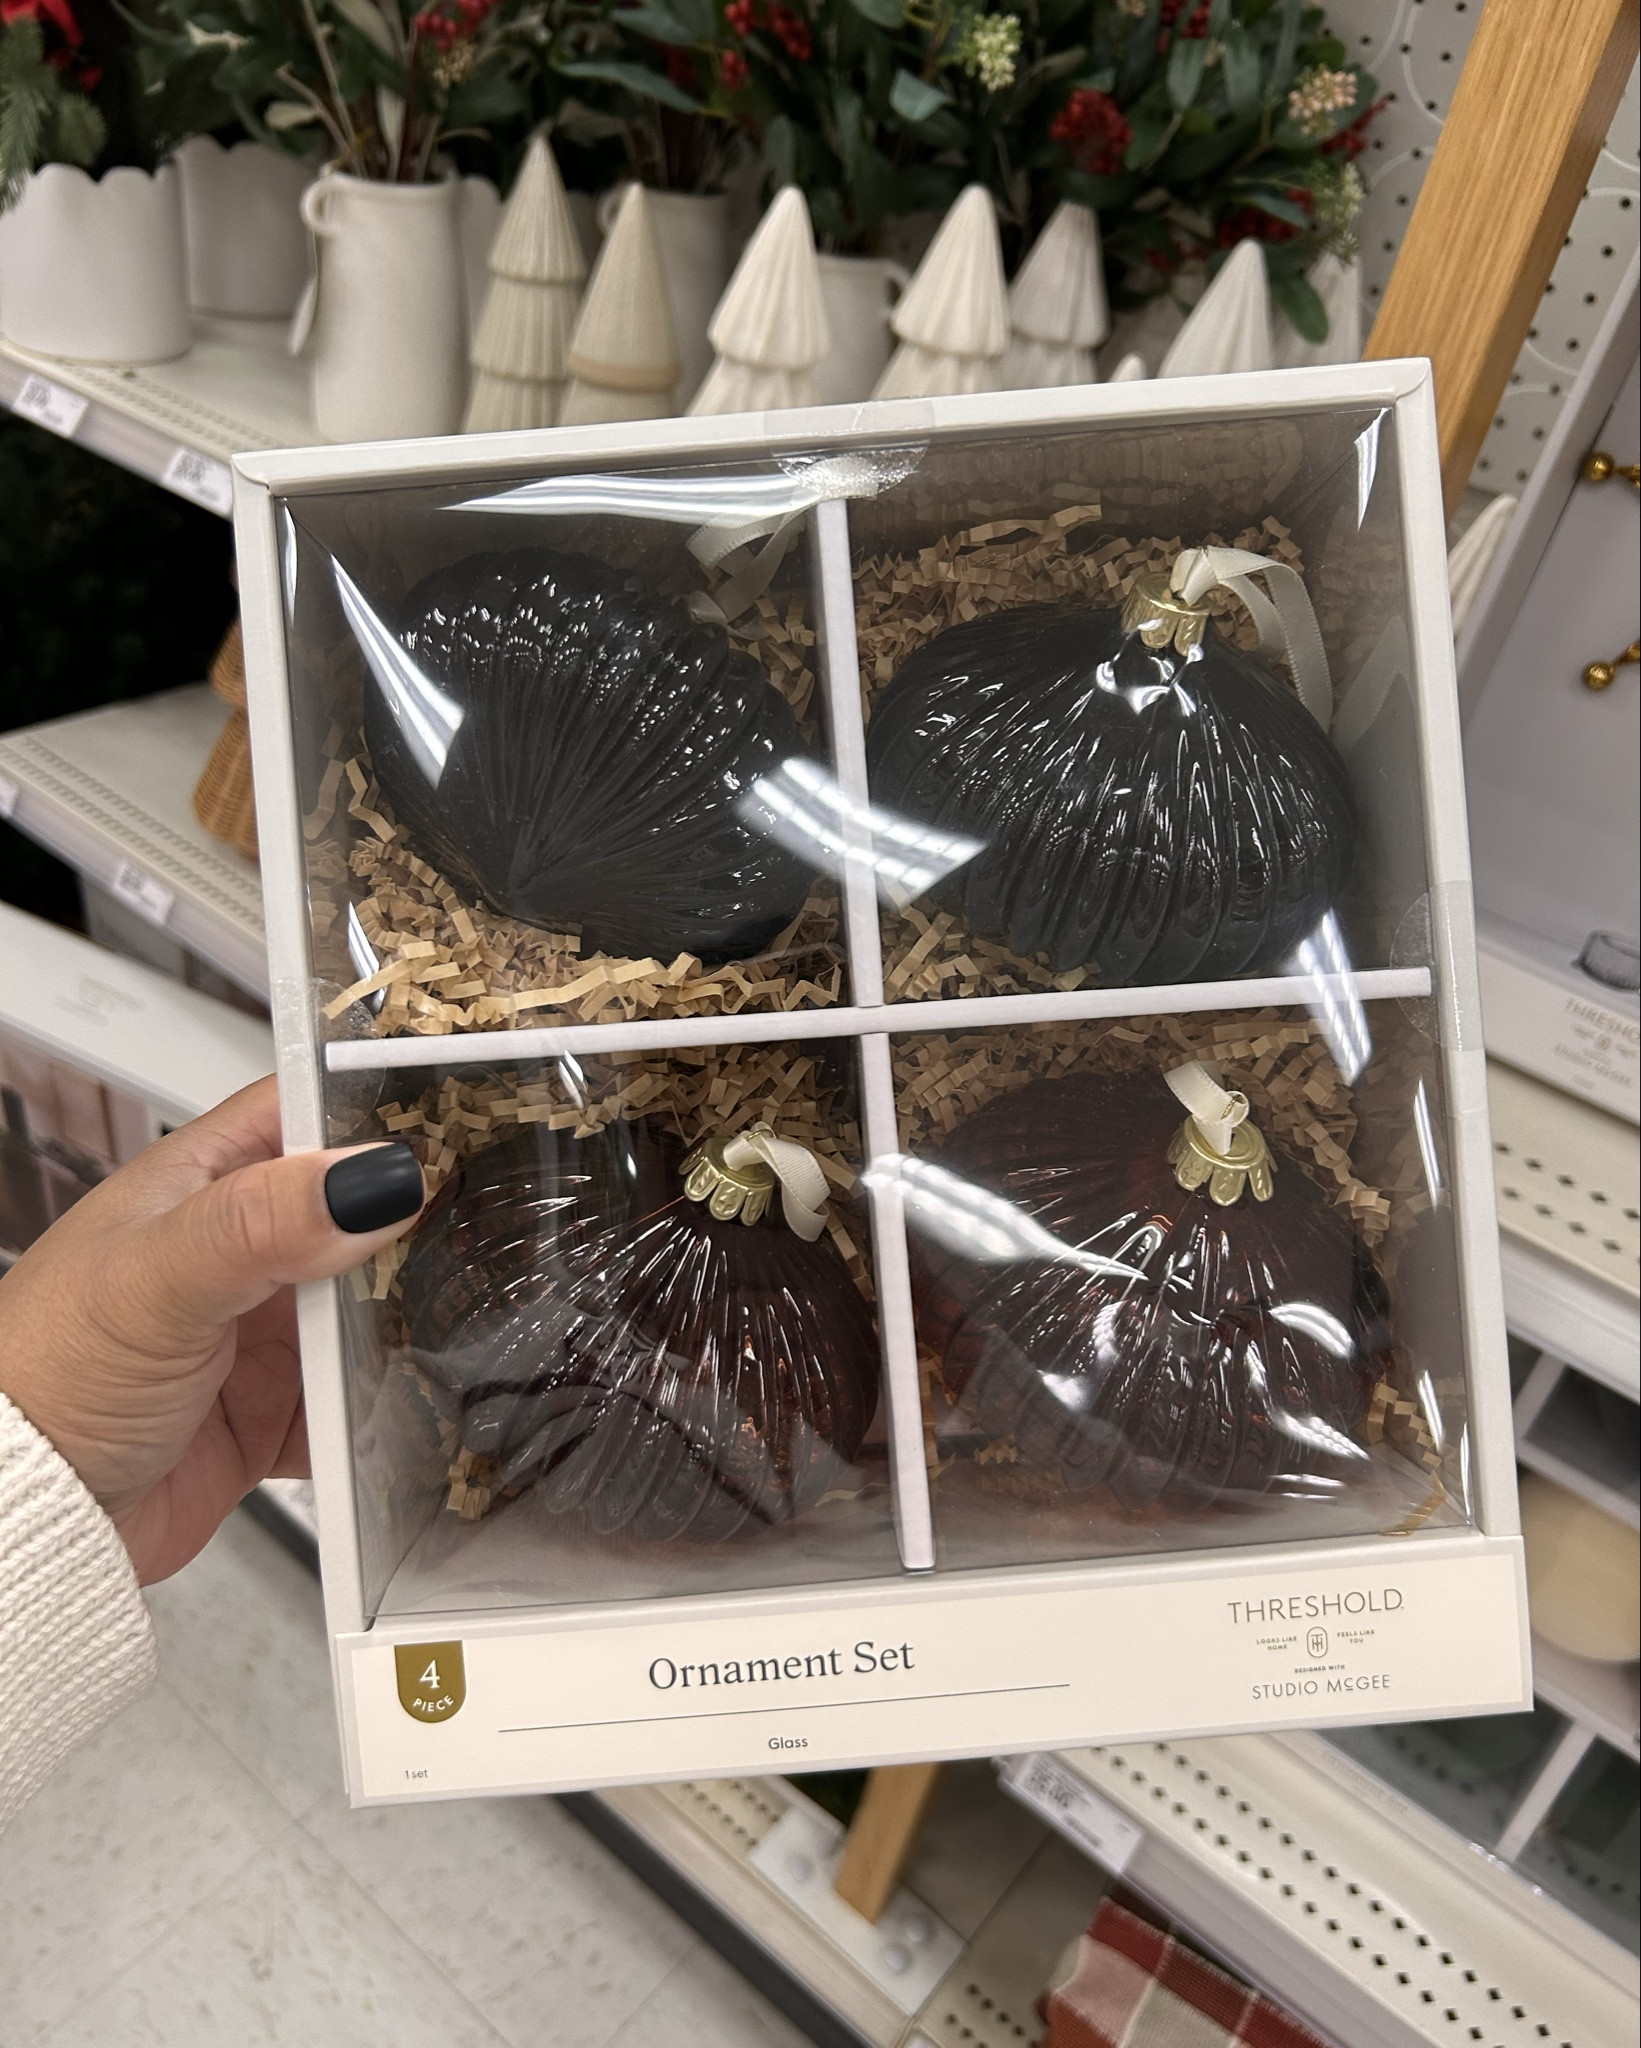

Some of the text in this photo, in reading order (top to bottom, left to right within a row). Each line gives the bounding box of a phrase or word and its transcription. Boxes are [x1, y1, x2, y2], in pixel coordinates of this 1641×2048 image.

[1337, 1630, 1357, 1638] FEELS
[419, 1660, 440, 1688] 4
[649, 1641, 915, 1689] Ornament Set
[1294, 1666, 1326, 1674] DESIGNED
[1252, 1681, 1318, 1699] STUDIO
[412, 1694, 454, 1712] PIECE
[768, 1736, 808, 1750] Glass
